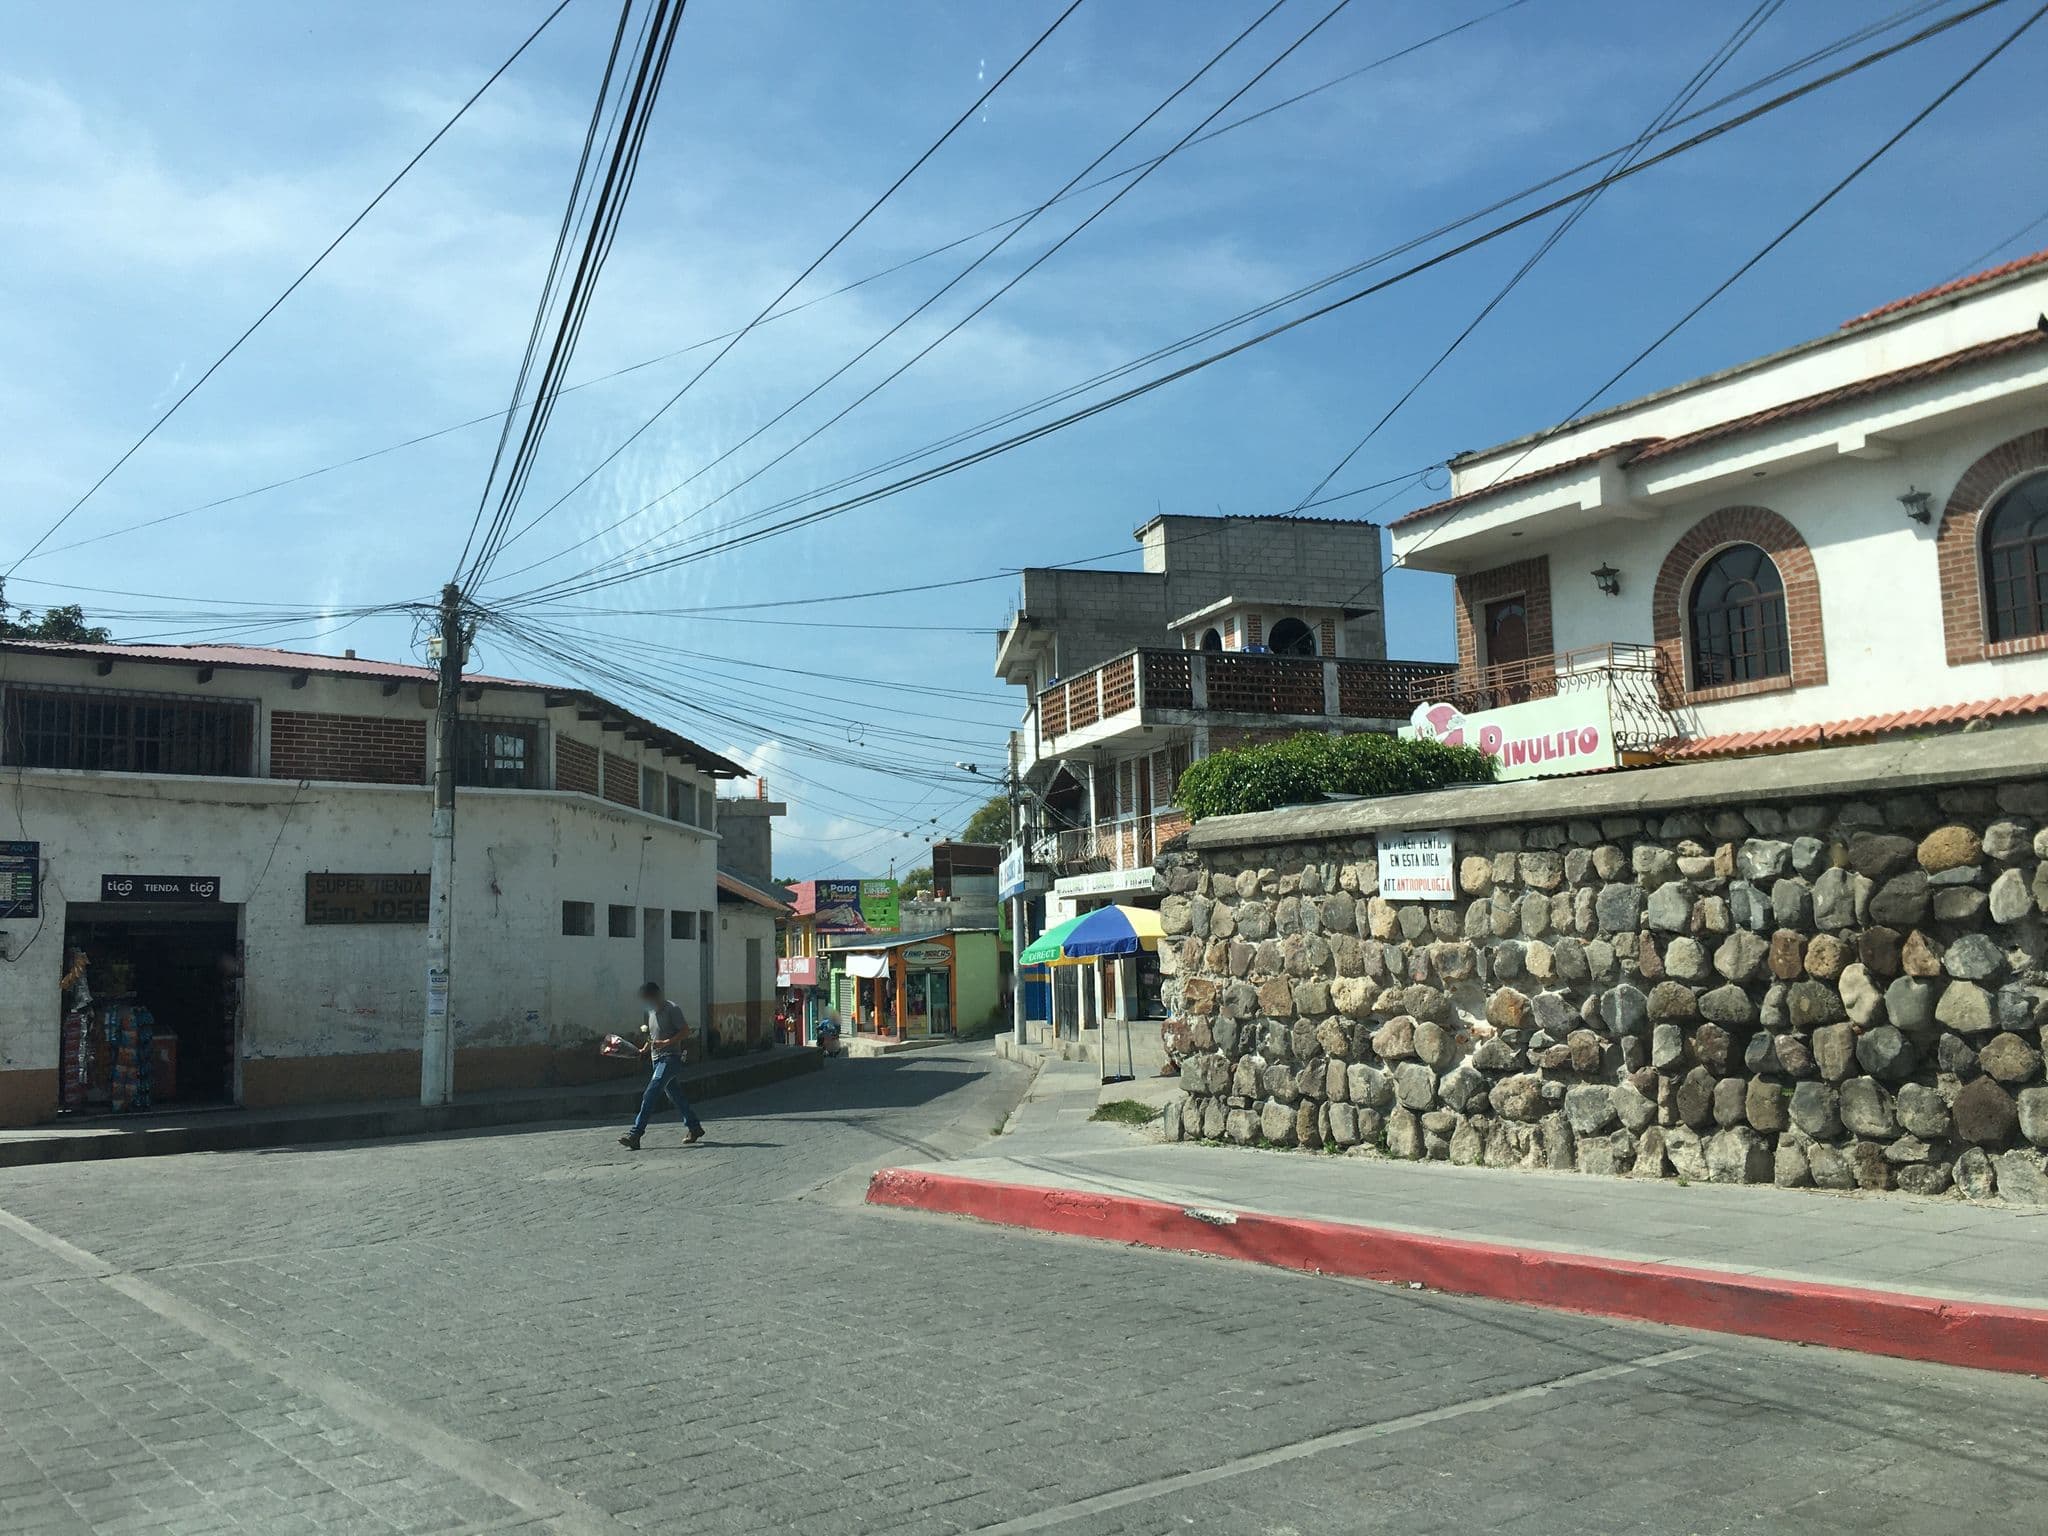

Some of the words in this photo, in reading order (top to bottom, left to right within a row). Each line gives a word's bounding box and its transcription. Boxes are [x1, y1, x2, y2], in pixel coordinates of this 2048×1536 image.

[1480, 725, 1598, 768] PINULITO
[1389, 854, 1400, 867] EN
[1402, 853, 1420, 867] ESTA
[144, 883, 180, 892] TIENDA
[315, 879, 365, 894] SUPER
[372, 879, 424, 894] TIENDA
[830, 884, 857, 893] Pana
[1028, 949, 1057, 961] DIRECT
